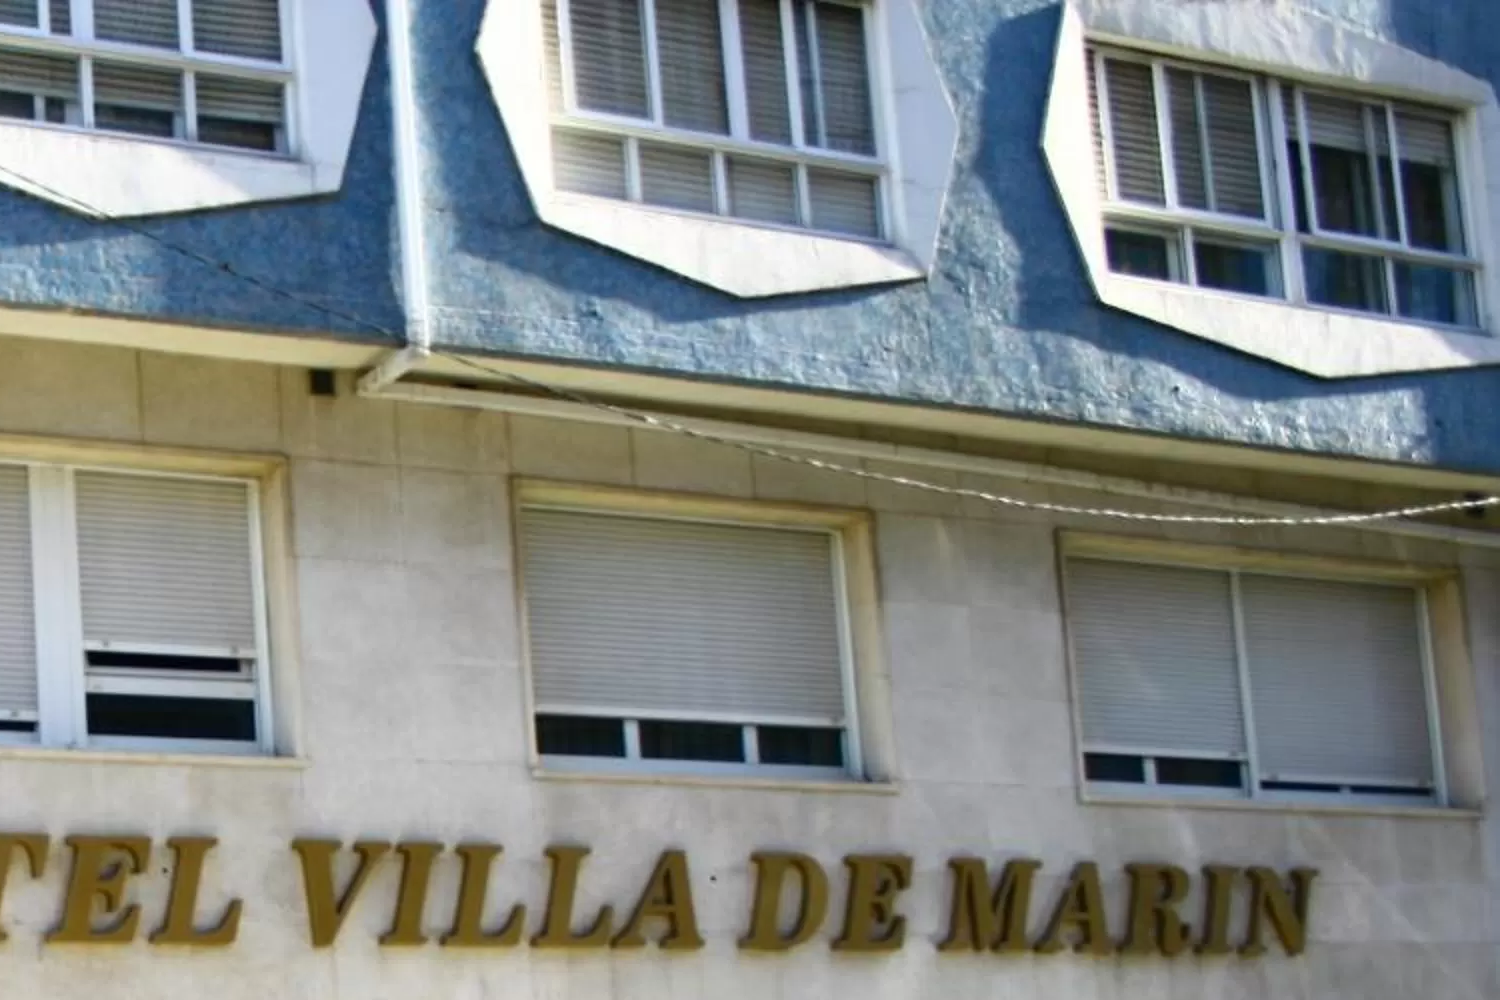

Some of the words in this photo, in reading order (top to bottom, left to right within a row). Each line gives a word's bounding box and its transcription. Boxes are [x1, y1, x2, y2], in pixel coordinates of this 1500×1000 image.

[291, 838, 706, 950] VILLA
[738, 850, 913, 953] DE
[937, 856, 1322, 957] MARIN
